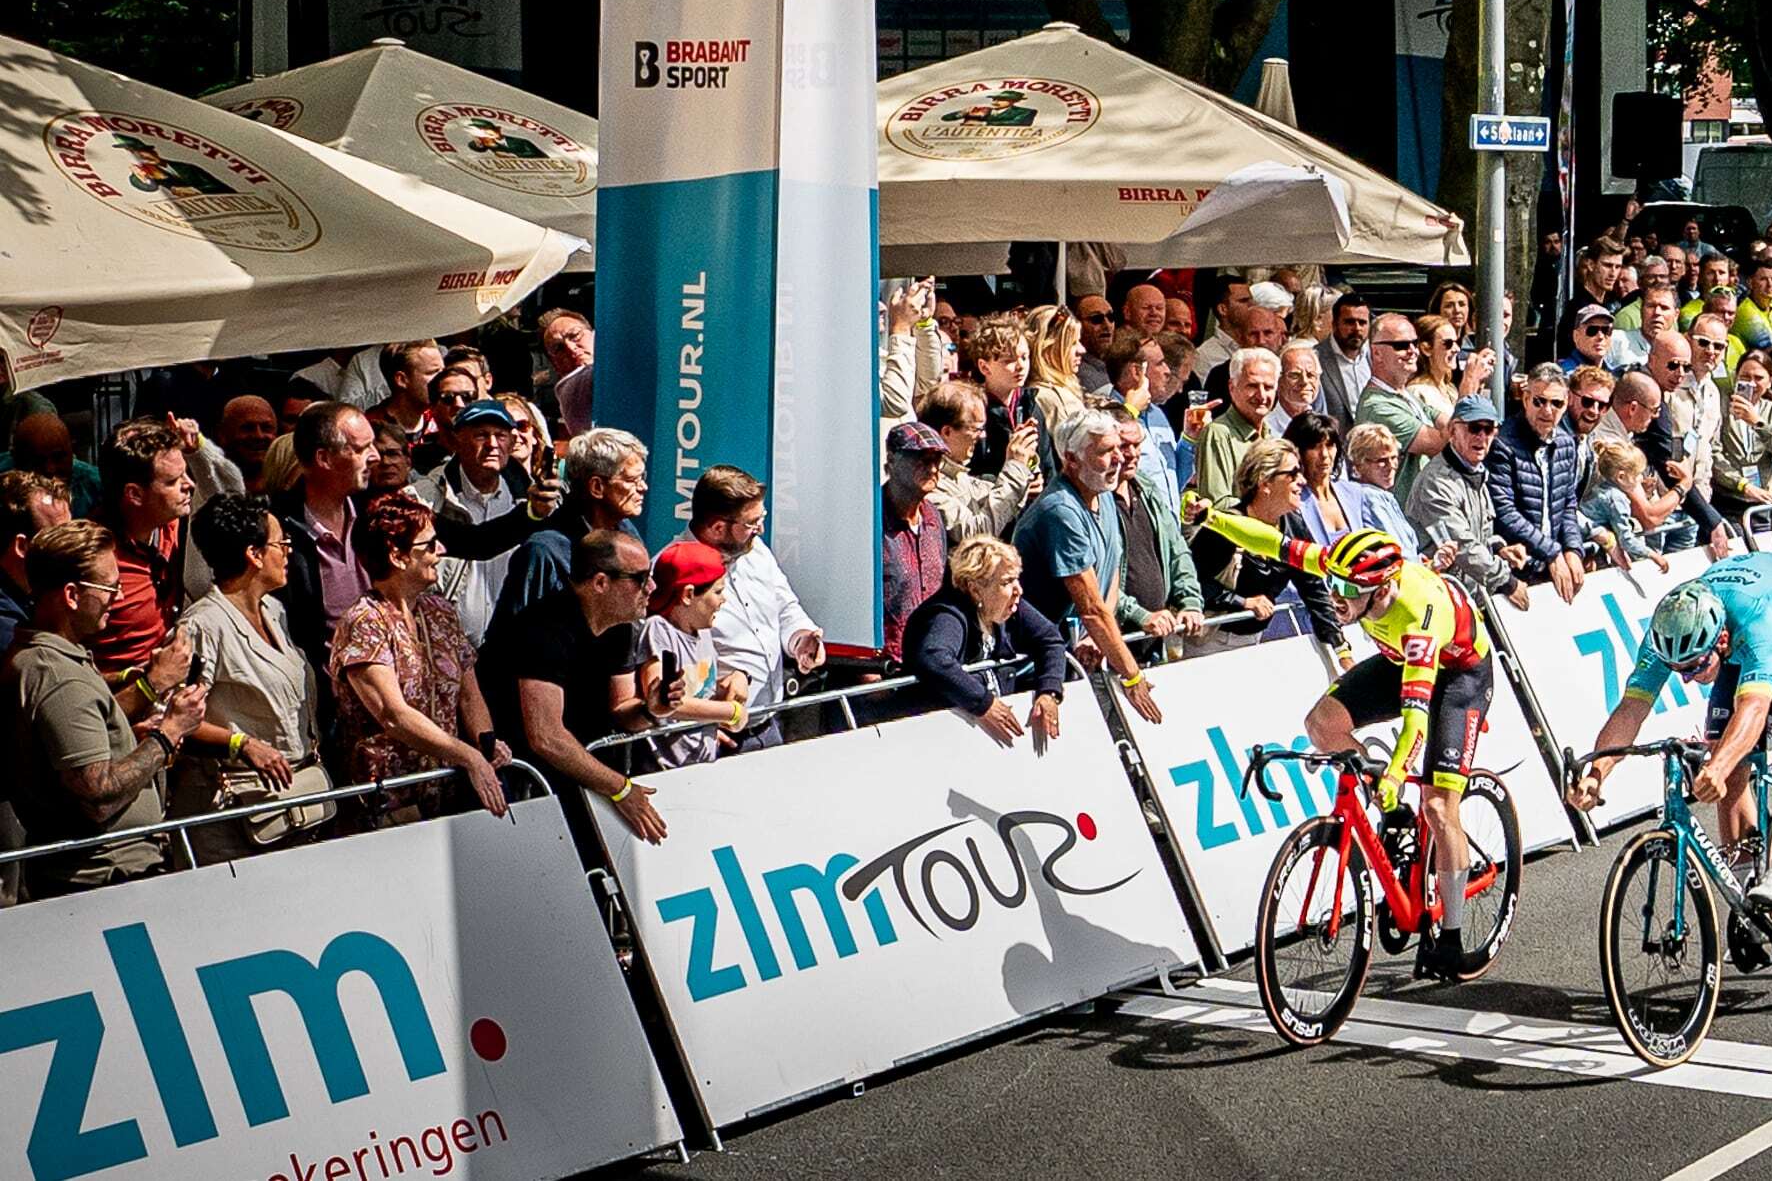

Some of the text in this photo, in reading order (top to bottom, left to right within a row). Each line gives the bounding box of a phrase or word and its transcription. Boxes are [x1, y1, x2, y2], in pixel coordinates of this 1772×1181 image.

[666, 39, 752, 63] BRABANT
[666, 66, 730, 89] SPORT
[898, 80, 1093, 123] BIRRA MORETTI
[423, 108, 458, 154] BIRRA
[54, 115, 271, 198] BIRRA MORETTI
[1118, 187, 1188, 202] BIRRA
[437, 270, 486, 291] BIRRA
[1468, 776, 1507, 803] URSUS
